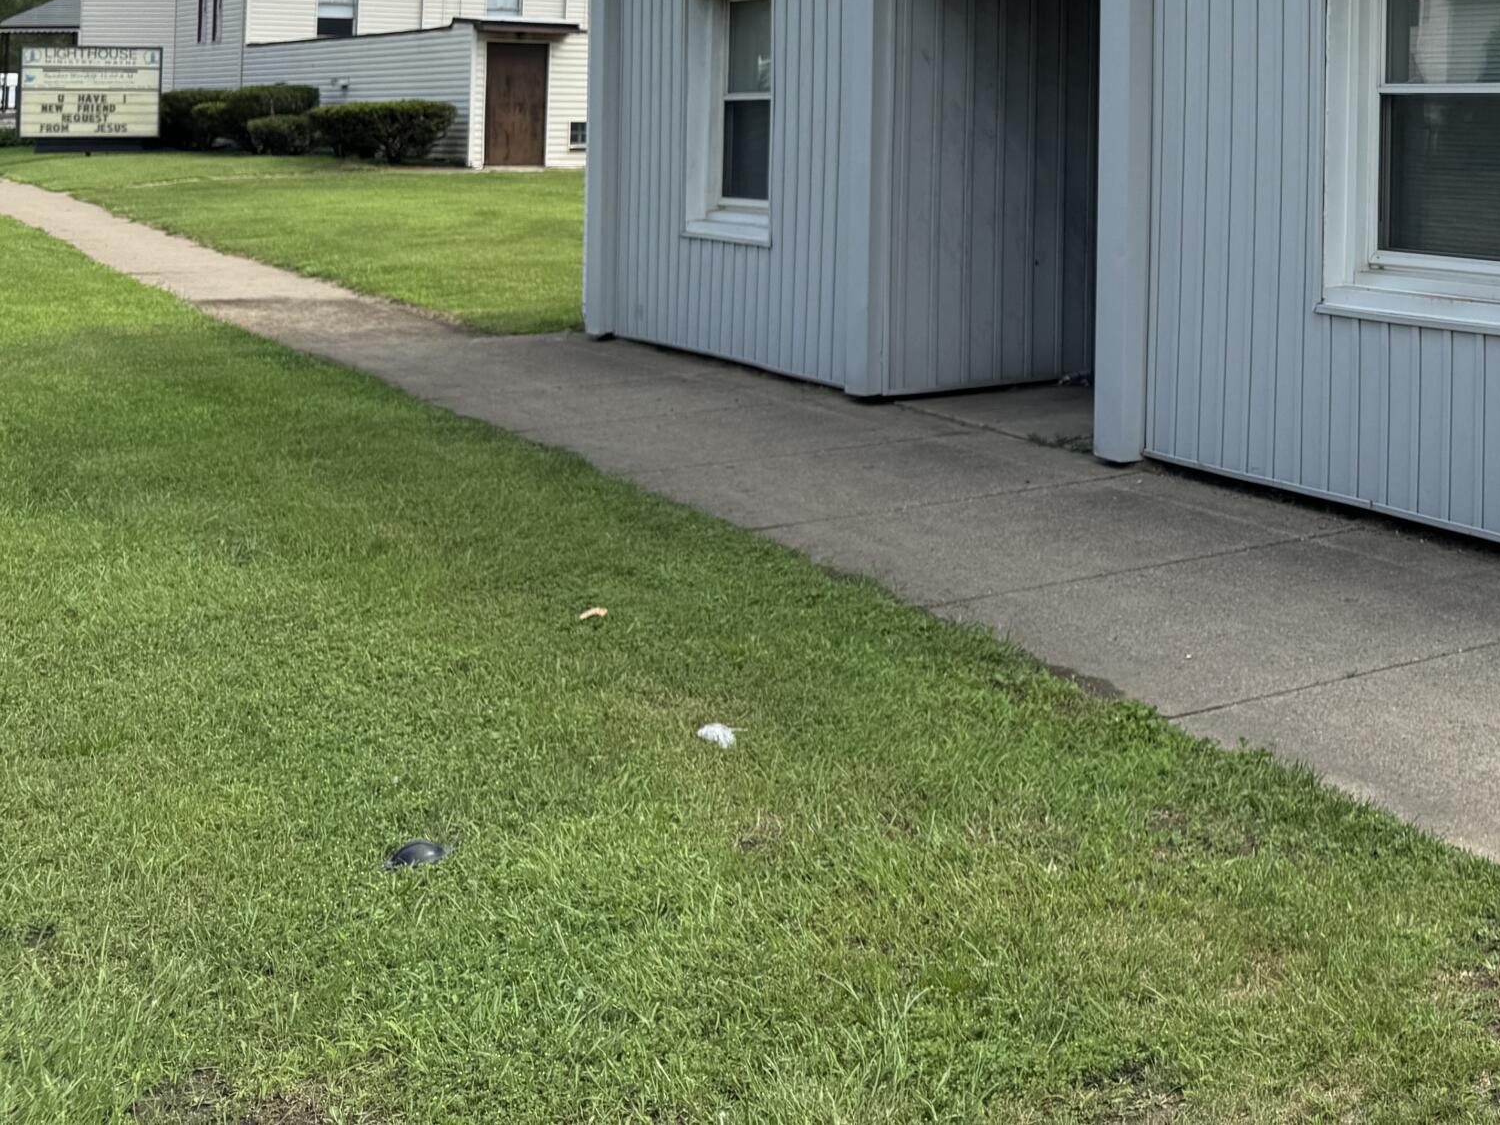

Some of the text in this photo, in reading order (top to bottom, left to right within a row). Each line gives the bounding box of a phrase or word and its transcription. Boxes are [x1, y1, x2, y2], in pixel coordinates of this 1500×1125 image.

[44, 48, 137, 60] LIGHTHOUSE
[58, 94, 64, 103] U
[77, 93, 107, 103] HAVE
[41, 104, 116, 113] NEW FRIEND
[61, 114, 108, 123] REQUEST
[39, 124, 128, 133] FROM JESUS
